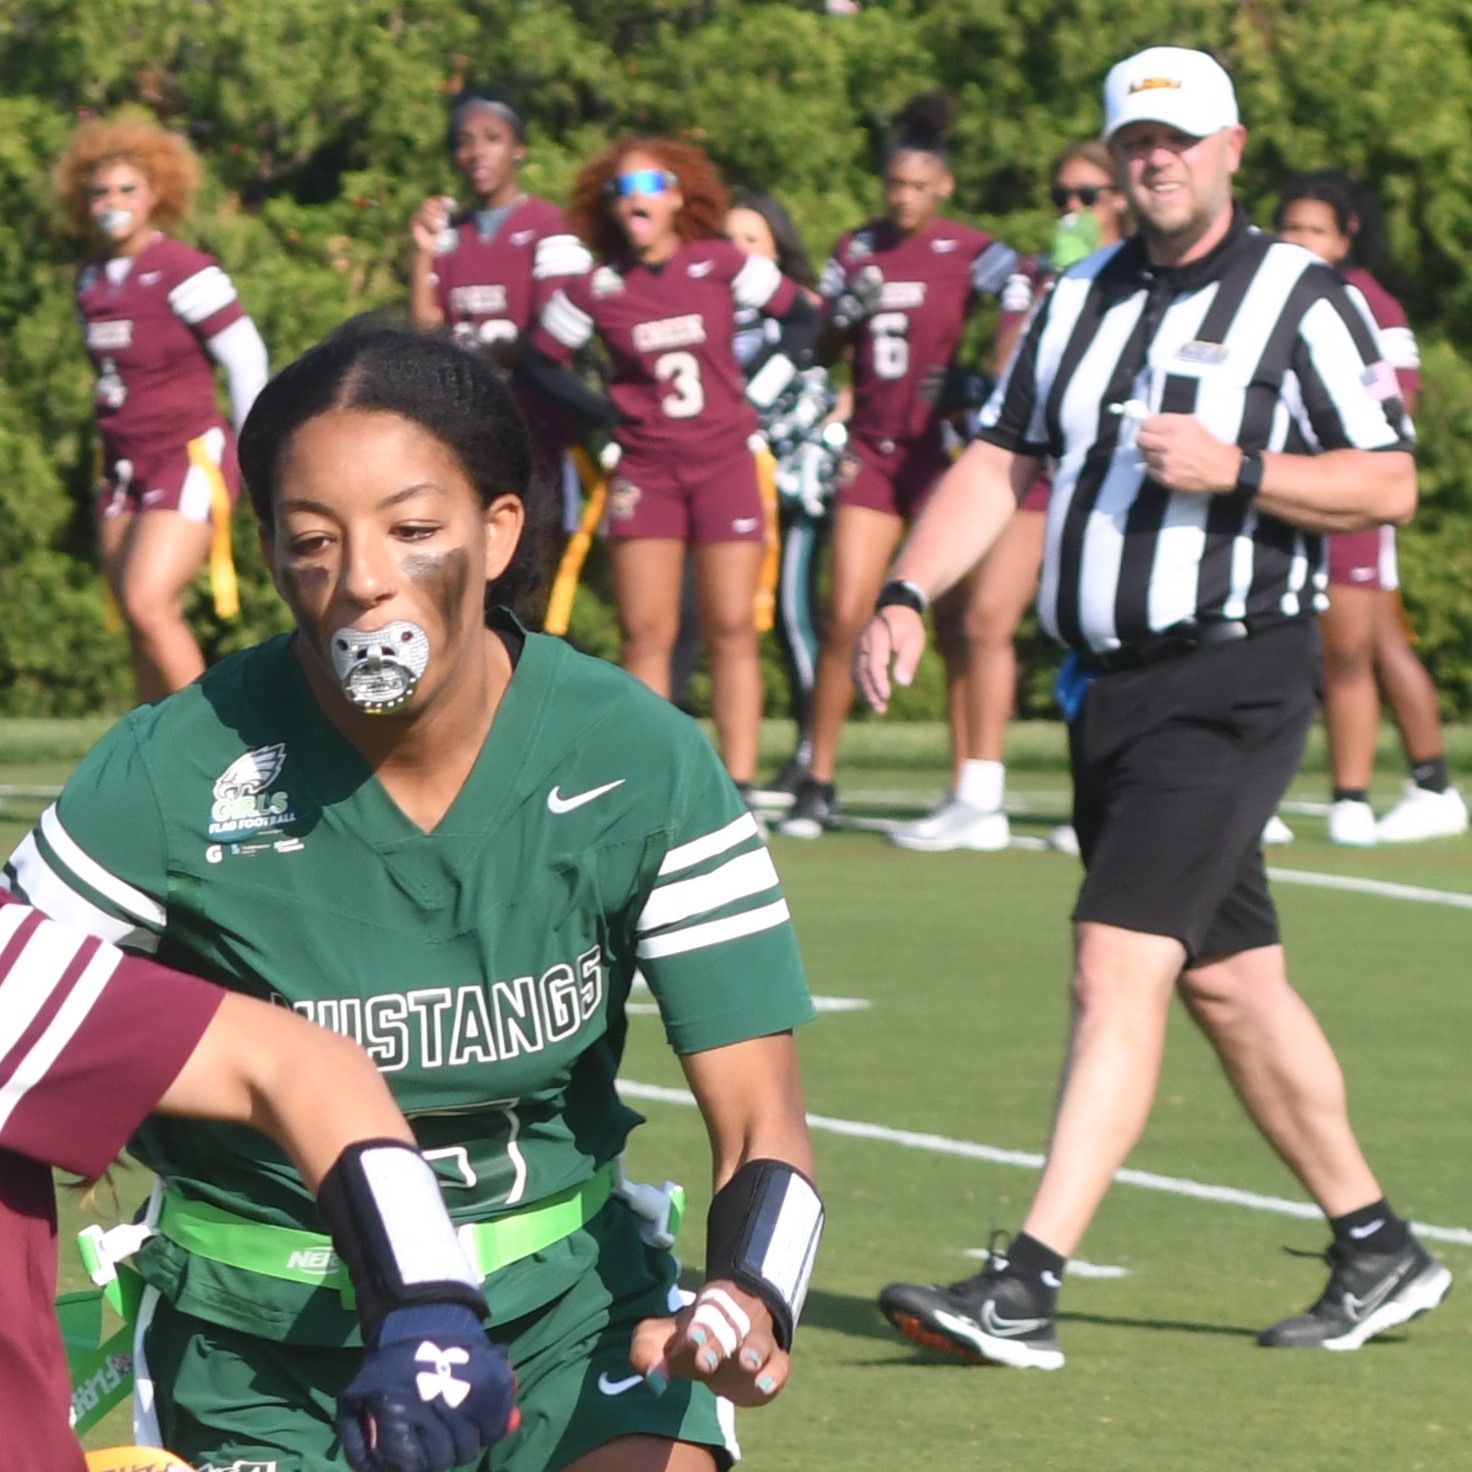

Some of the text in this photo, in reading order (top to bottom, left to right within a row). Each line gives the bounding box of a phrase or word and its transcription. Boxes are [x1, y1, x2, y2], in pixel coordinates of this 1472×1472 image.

[656, 350, 704, 419] 3
[211, 791, 288, 822] GIRLS
[205, 844, 223, 863] G
